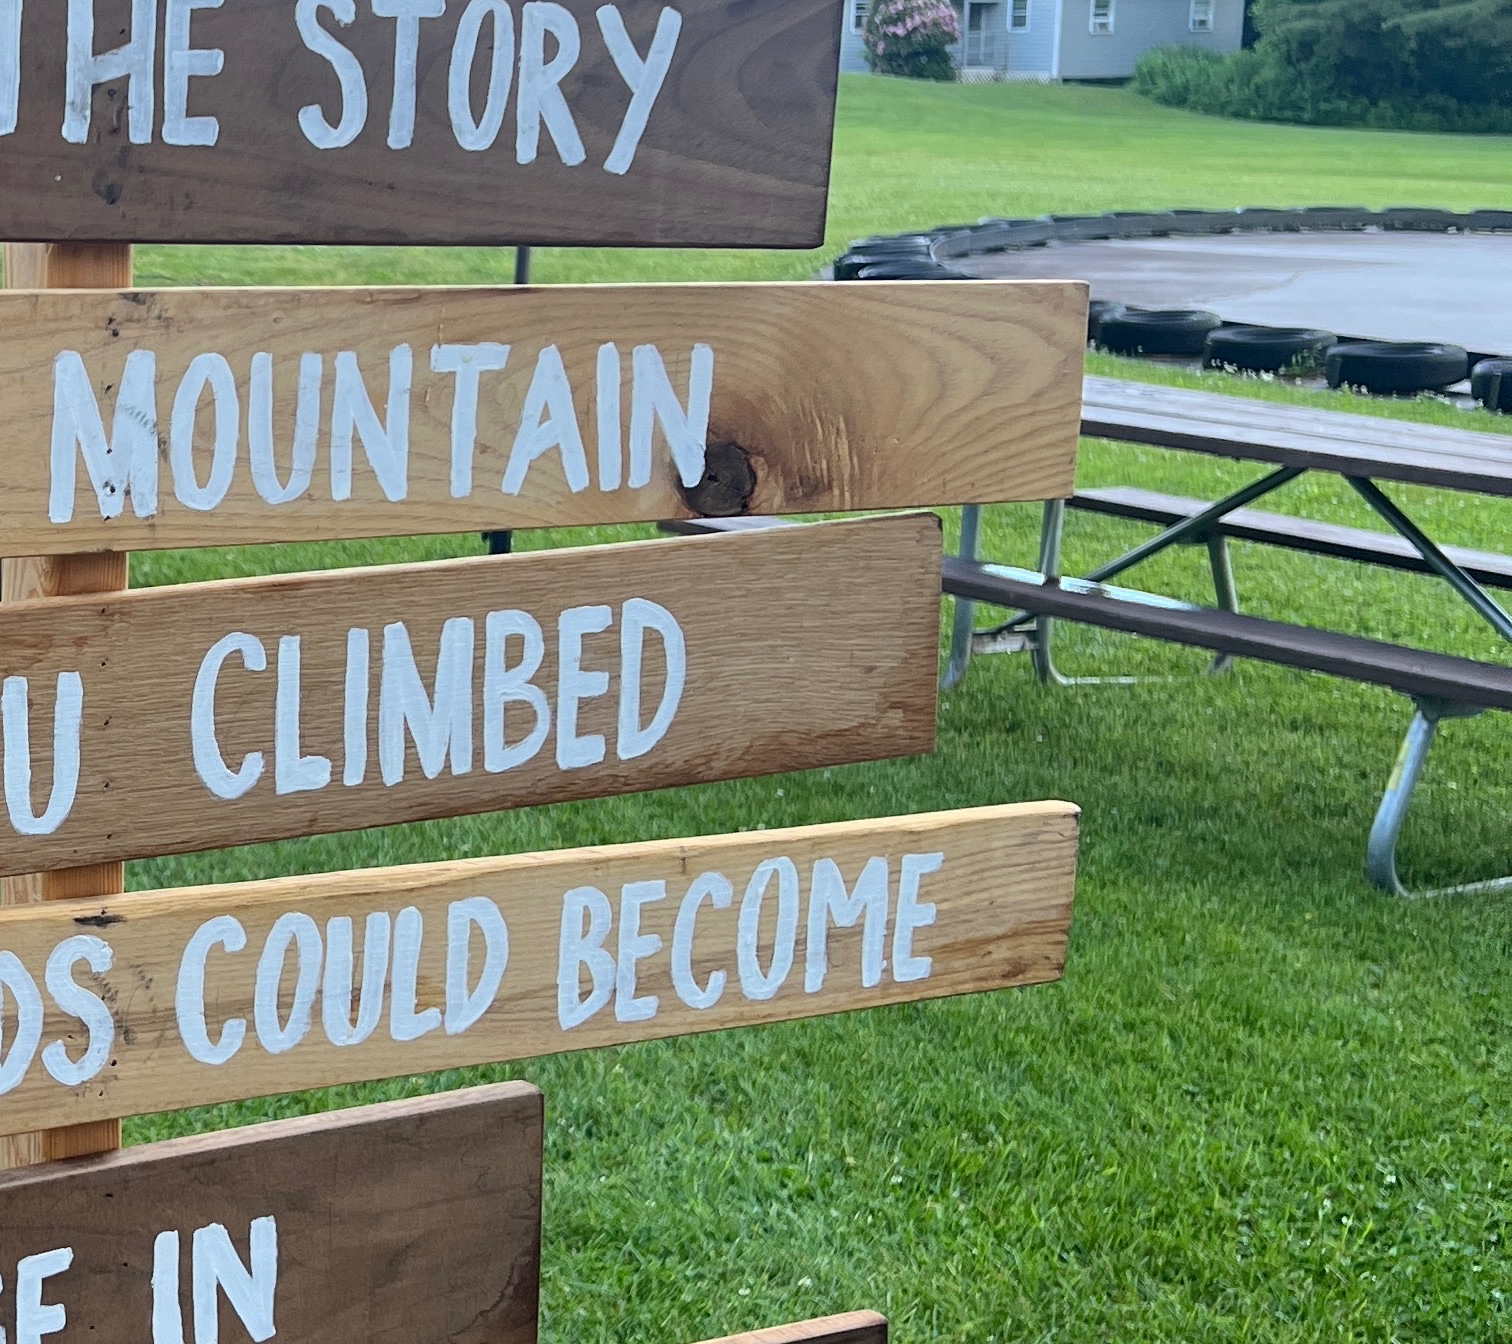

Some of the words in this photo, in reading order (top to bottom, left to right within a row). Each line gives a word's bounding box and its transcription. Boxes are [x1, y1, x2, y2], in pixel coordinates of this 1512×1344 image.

[48, 342, 716, 523] MOUNTAIN
[191, 599, 685, 800] CLIMBED
[172, 895, 509, 1067] COULD
[554, 849, 944, 1031] BECOME
